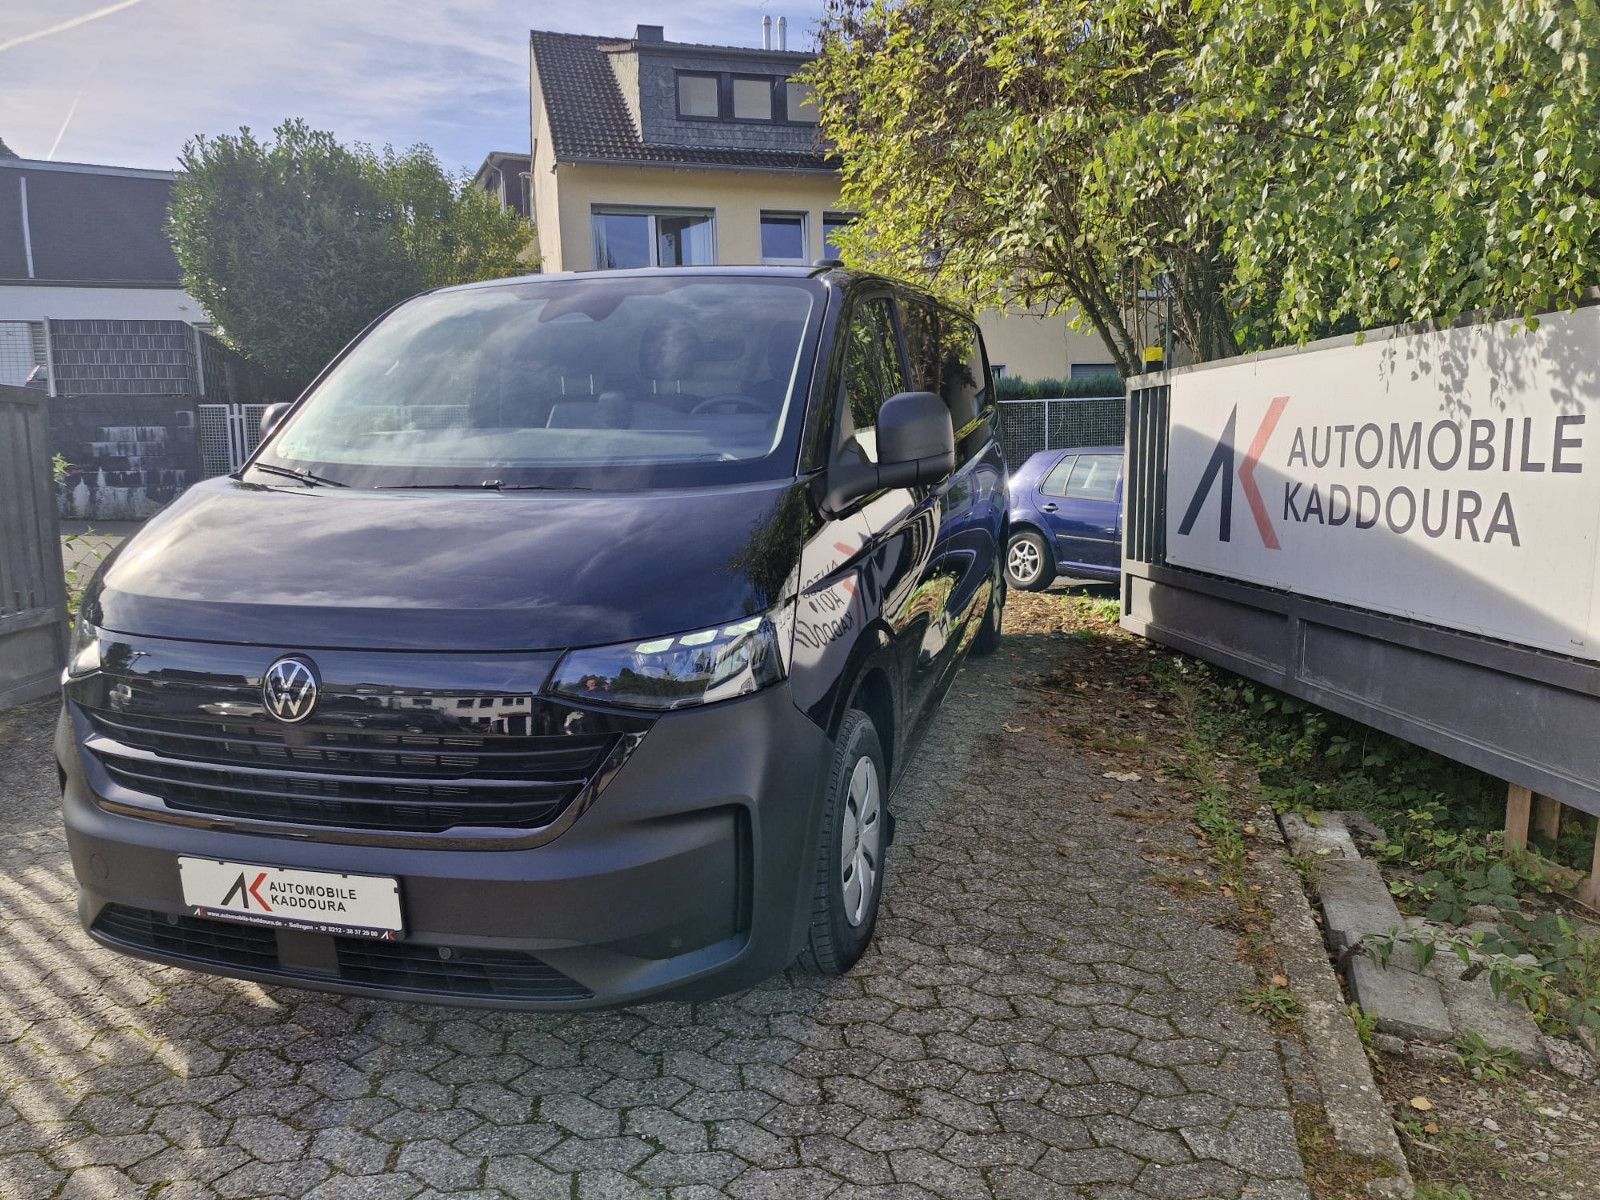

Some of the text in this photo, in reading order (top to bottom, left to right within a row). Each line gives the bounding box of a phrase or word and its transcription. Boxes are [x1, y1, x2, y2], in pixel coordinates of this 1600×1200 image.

[1286, 414, 1586, 474] AUTOMOBILE
[1283, 481, 1521, 547] KADDOURA
[266, 661, 314, 718] VW
[269, 881, 357, 900] AUTOMOBILE
[271, 894, 347, 912] KADDOURA
